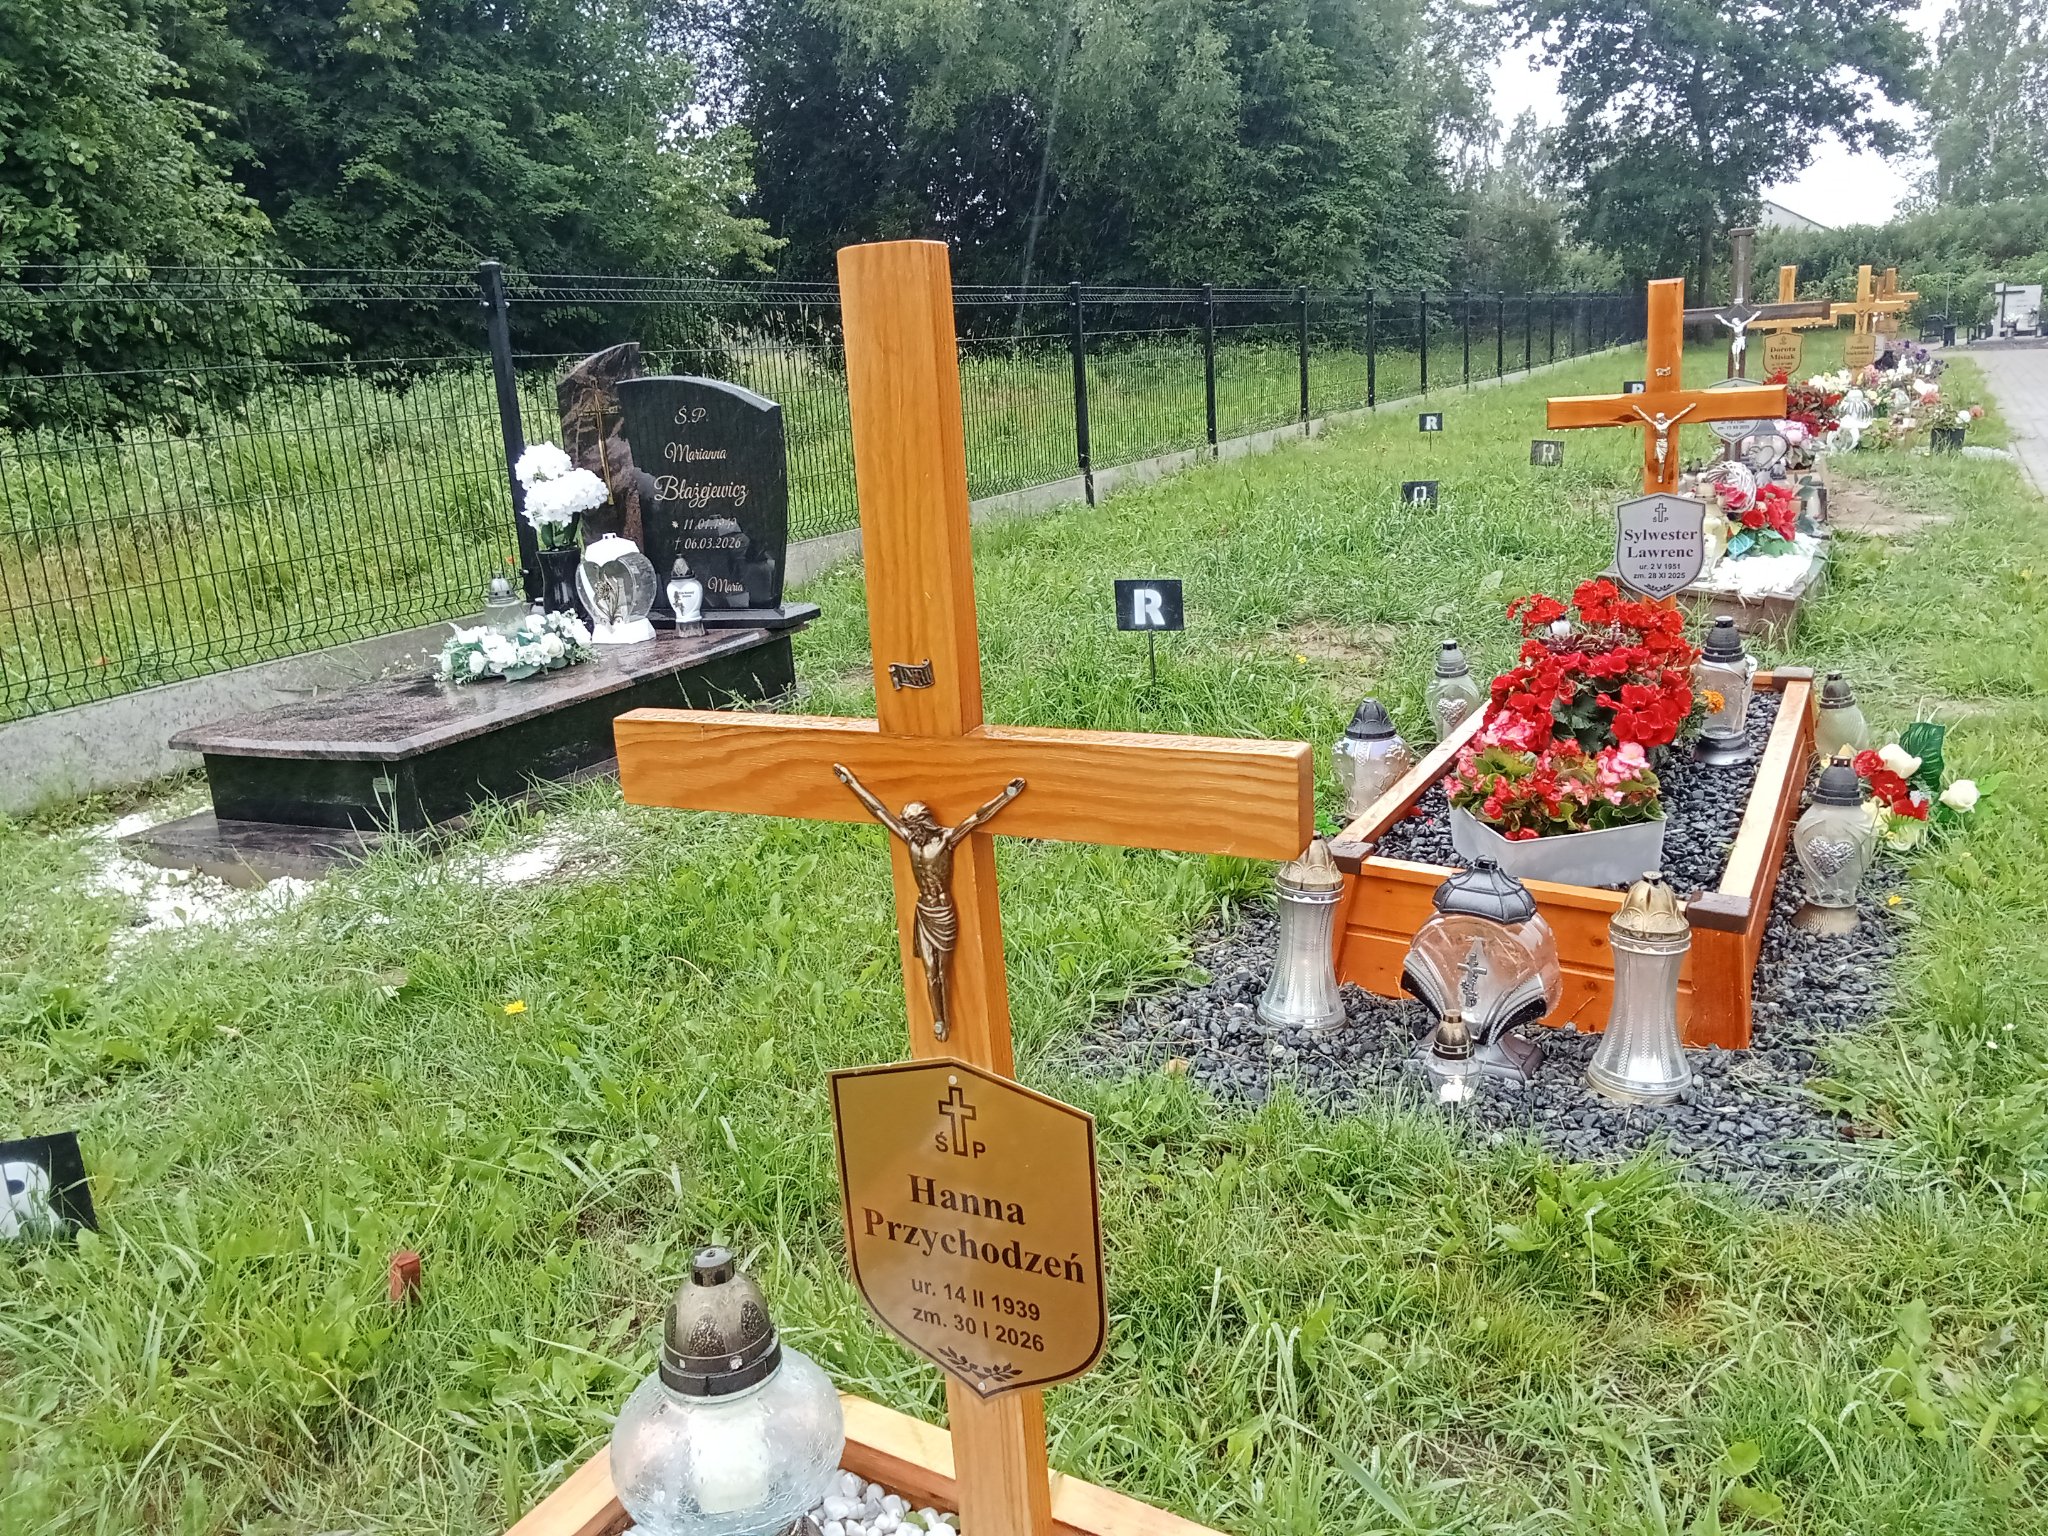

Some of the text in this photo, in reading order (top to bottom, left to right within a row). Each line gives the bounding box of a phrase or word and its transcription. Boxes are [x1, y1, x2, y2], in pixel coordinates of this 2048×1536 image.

[1425, 415, 1438, 430] R
[664, 441, 727, 463] Marianna
[1542, 443, 1555, 463] R
[654, 475, 749, 508] Błażejewicz
[684, 537, 741, 550] 06.03.2026
[1624, 528, 1698, 544] Sylwester
[1627, 546, 1694, 558] Lawrenc
[707, 576, 743, 594] Maria
[1133, 588, 1166, 626] R
[935, 1131, 986, 1159] Ś P
[907, 1173, 1027, 1226] Hanna
[861, 1206, 1087, 1285] Przychodzeń
[911, 1279, 1041, 1321] ur. 14 II 1939
[912, 1307, 1046, 1353] zm. 30 I 2026
